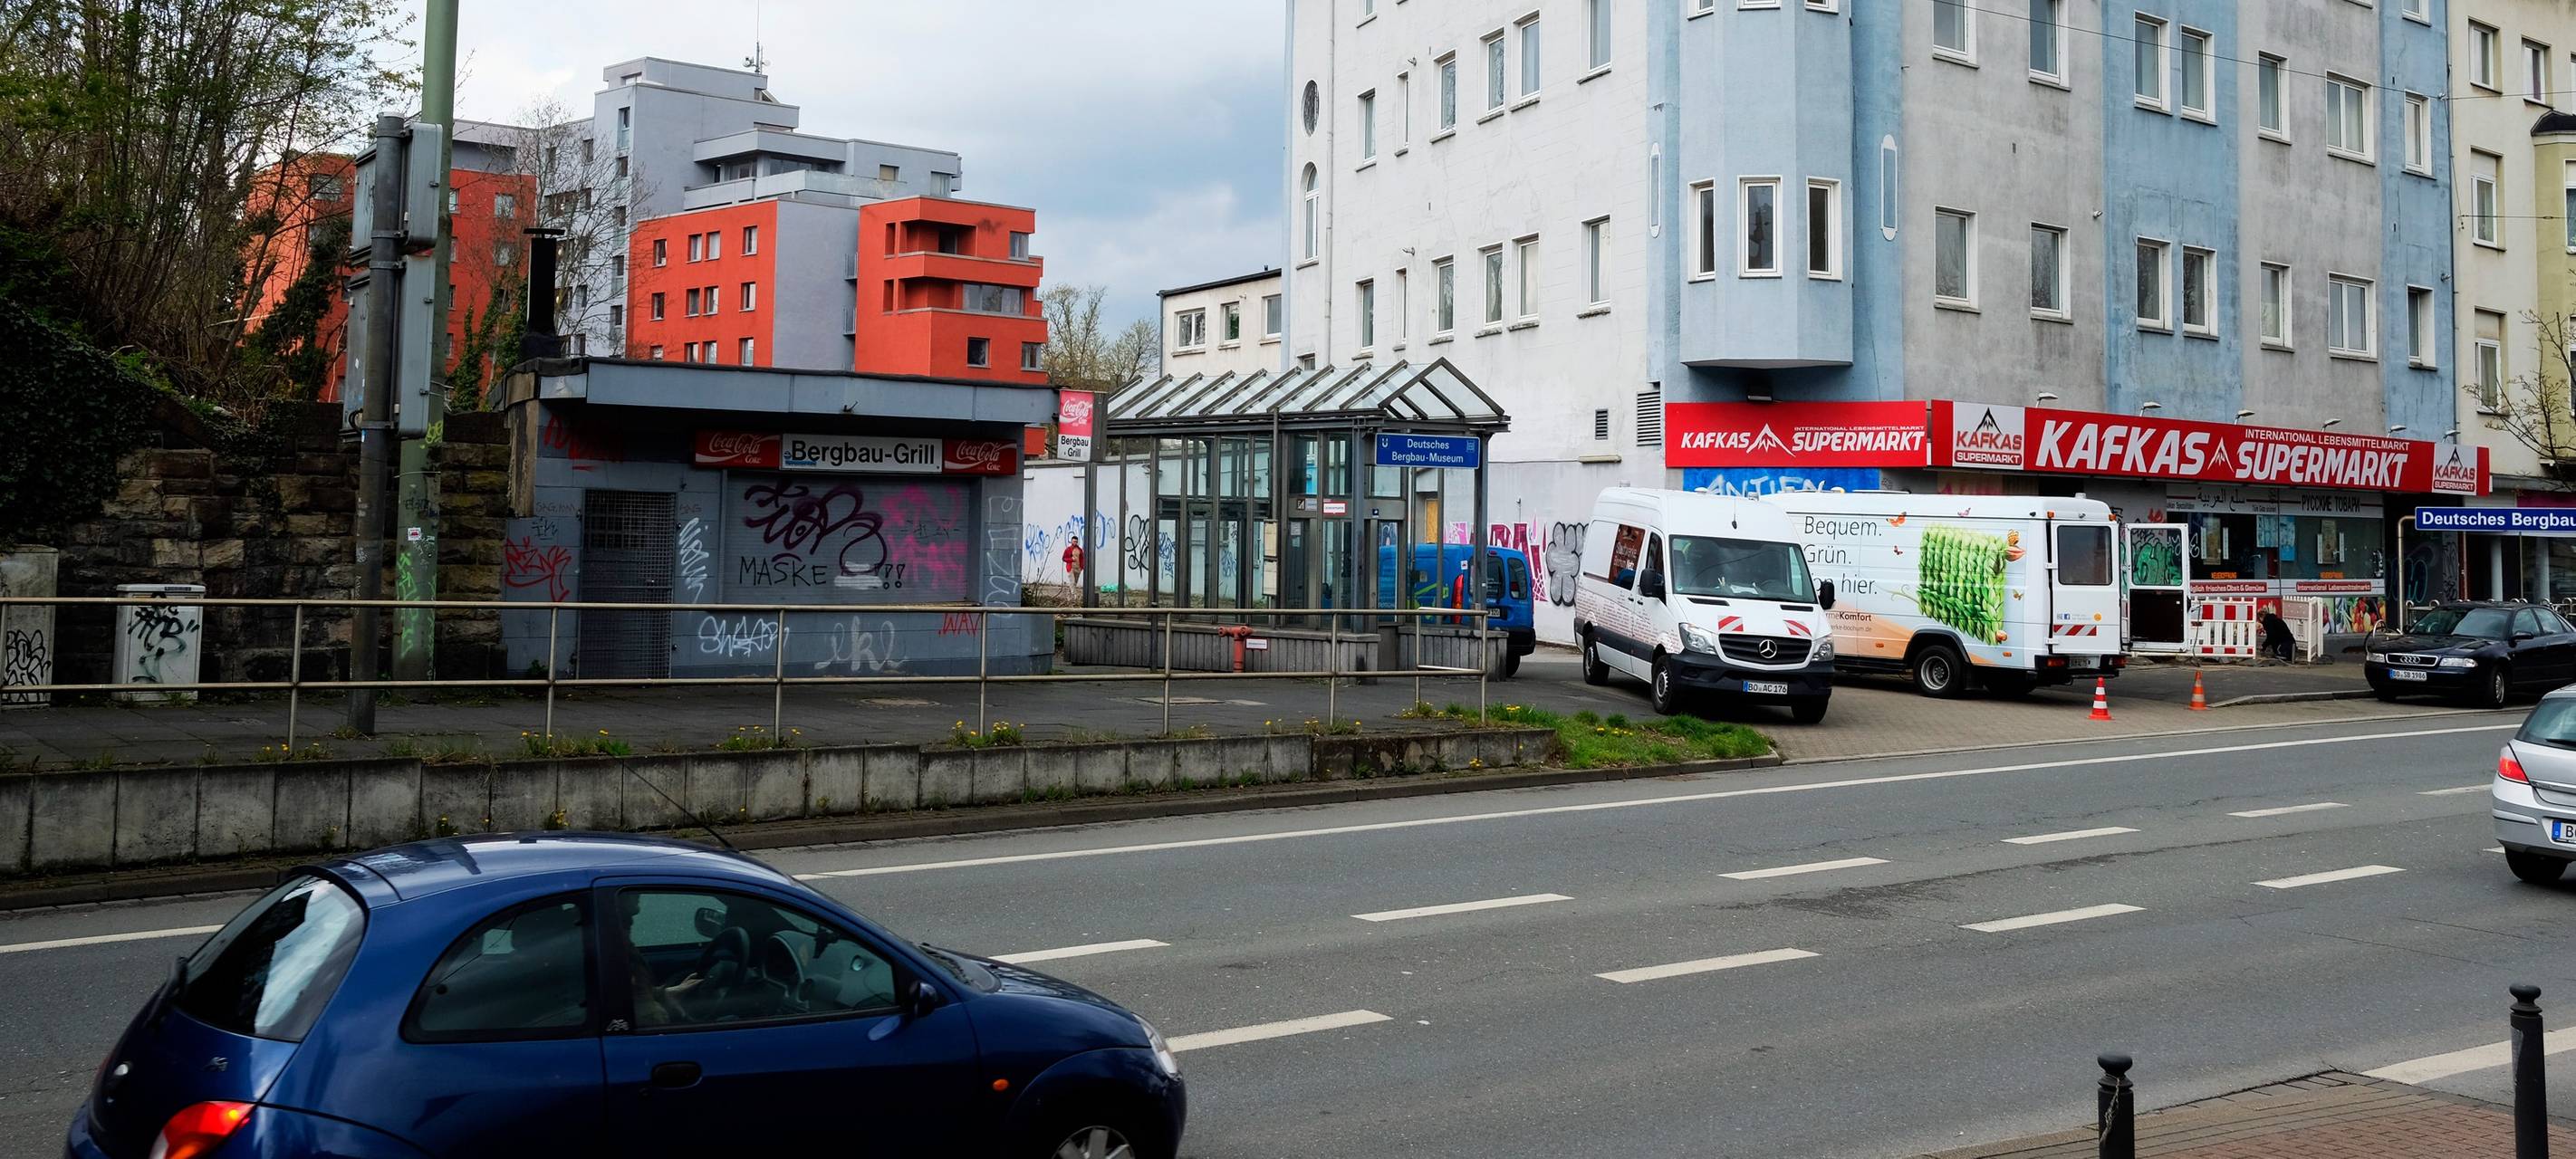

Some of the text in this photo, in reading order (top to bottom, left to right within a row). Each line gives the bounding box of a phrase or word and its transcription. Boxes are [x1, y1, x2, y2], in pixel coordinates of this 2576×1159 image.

[1061, 436, 1090, 447] Bergbau
[1407, 438, 1450, 450] Deutsches
[1680, 430, 1926, 453] KAFKAS SUPERMARKT
[1956, 430, 2023, 451] KAFKAS
[2245, 428, 2410, 451] INTERNATIONAL LEBENSMITTELMARKT
[792, 439, 935, 467] Bergbau-Grill
[1067, 447, 1081, 457] Grill
[1391, 451, 1464, 465] Bergbau-Museum
[1956, 452, 2021, 464] SUPERMARKT
[2036, 420, 2408, 487] KAFKAS SUPERMARKT
[2435, 465, 2475, 481] KAFKAS
[2434, 481, 2475, 492] SUPERMARKT
[2301, 494, 2332, 512] РУССКИЕ
[2422, 511, 2506, 526] Deutsches
[1804, 515, 1882, 540] Bequem.
[1803, 543, 1851, 565] Grün.
[739, 556, 828, 587] MASKE
[1841, 573, 1878, 595] hier.
[2226, 584, 2240, 592] Obst
[1748, 683, 1787, 694] BO AC 176
